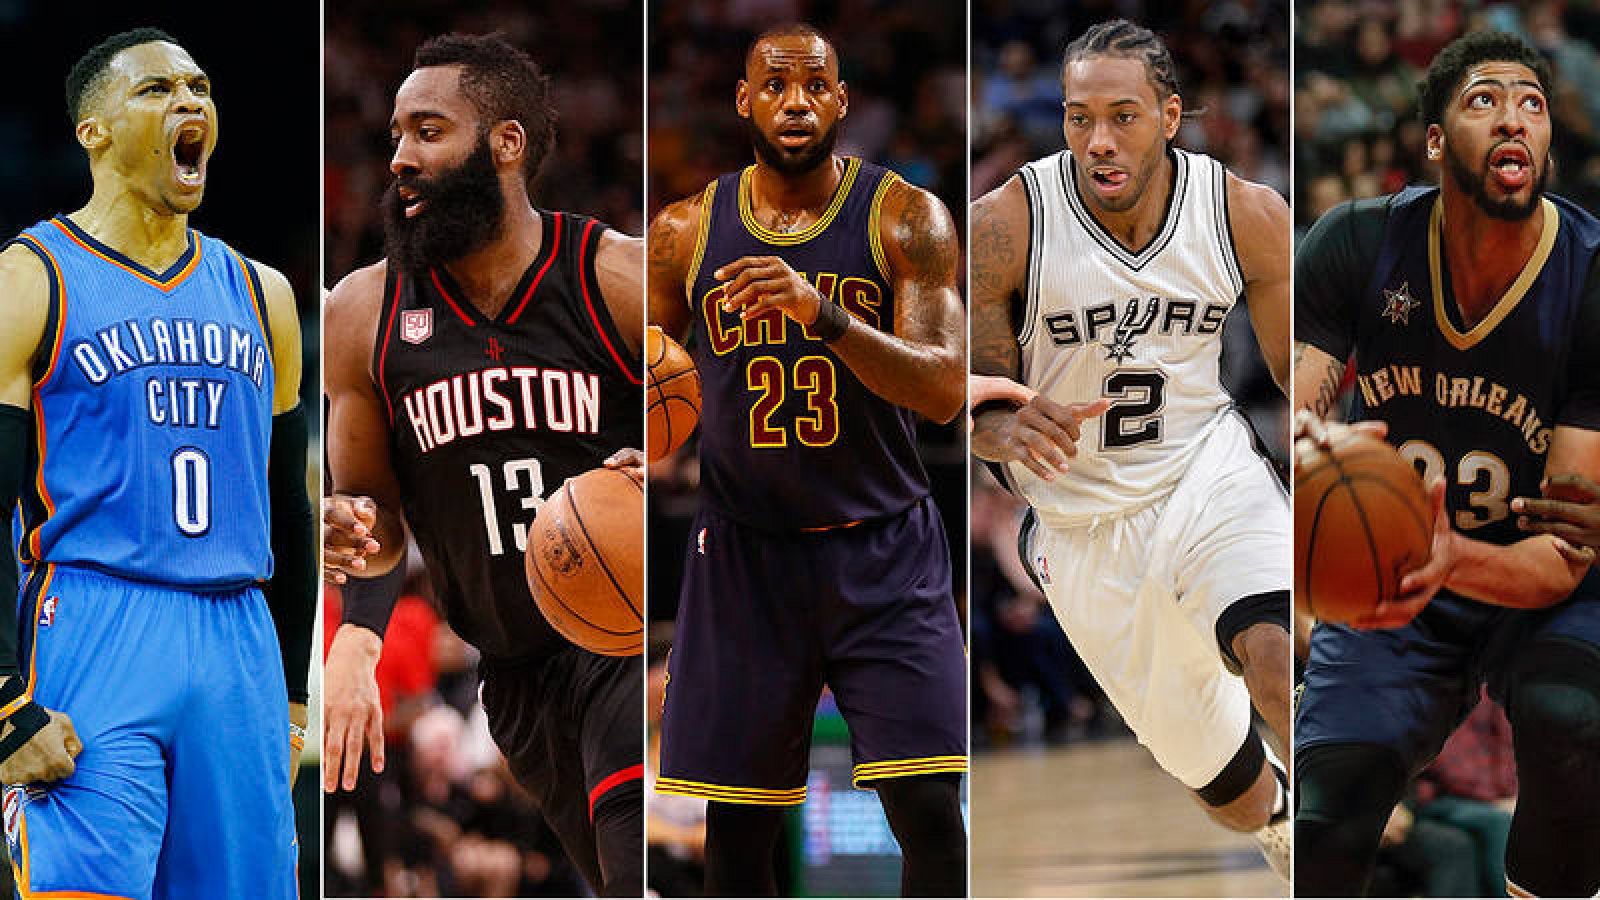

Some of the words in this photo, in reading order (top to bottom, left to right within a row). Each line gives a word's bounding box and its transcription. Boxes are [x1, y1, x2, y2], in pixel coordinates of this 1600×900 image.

[72, 317, 266, 389] OKLAHOMA
[1043, 298, 1228, 361] SPURS
[145, 375, 227, 429] CITY
[403, 367, 601, 453] HOUSTON
[747, 355, 839, 448] 23
[1098, 367, 1168, 452] 2
[1357, 365, 1423, 407] NEW
[1435, 372, 1551, 454] ORLEANS
[170, 446, 210, 537] 0
